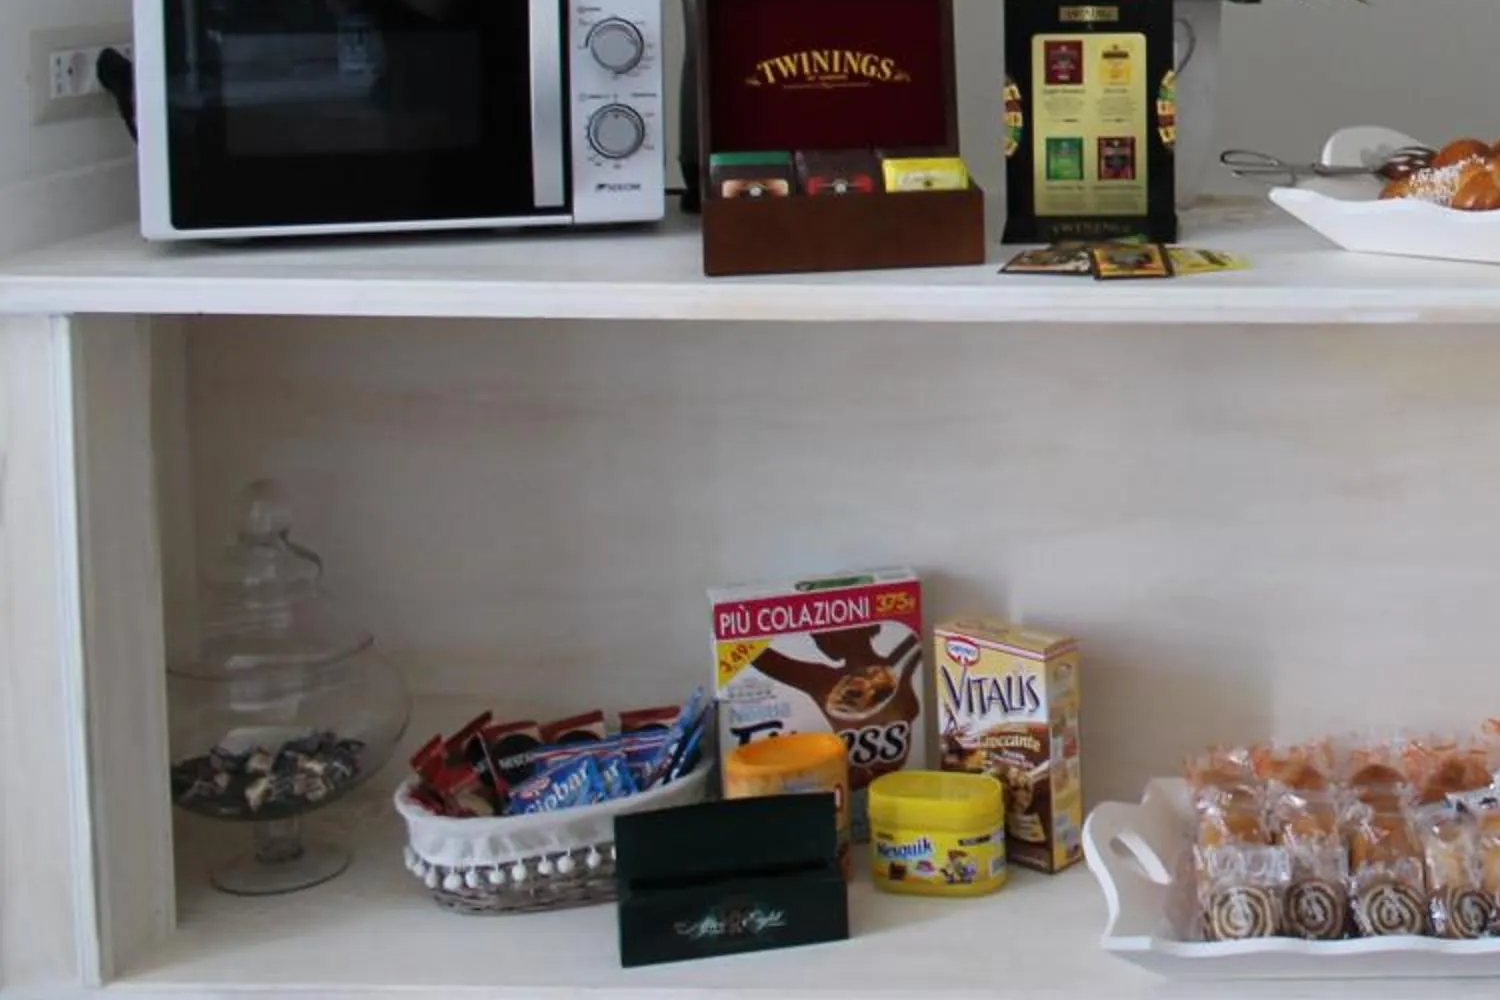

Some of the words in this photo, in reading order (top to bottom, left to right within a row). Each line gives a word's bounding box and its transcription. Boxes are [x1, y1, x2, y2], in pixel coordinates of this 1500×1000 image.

[756, 49, 896, 85] TWININGS
[720, 605, 750, 636] PIÙ
[757, 596, 870, 632] COLAZIONI
[941, 664, 1042, 715] VITALIS
